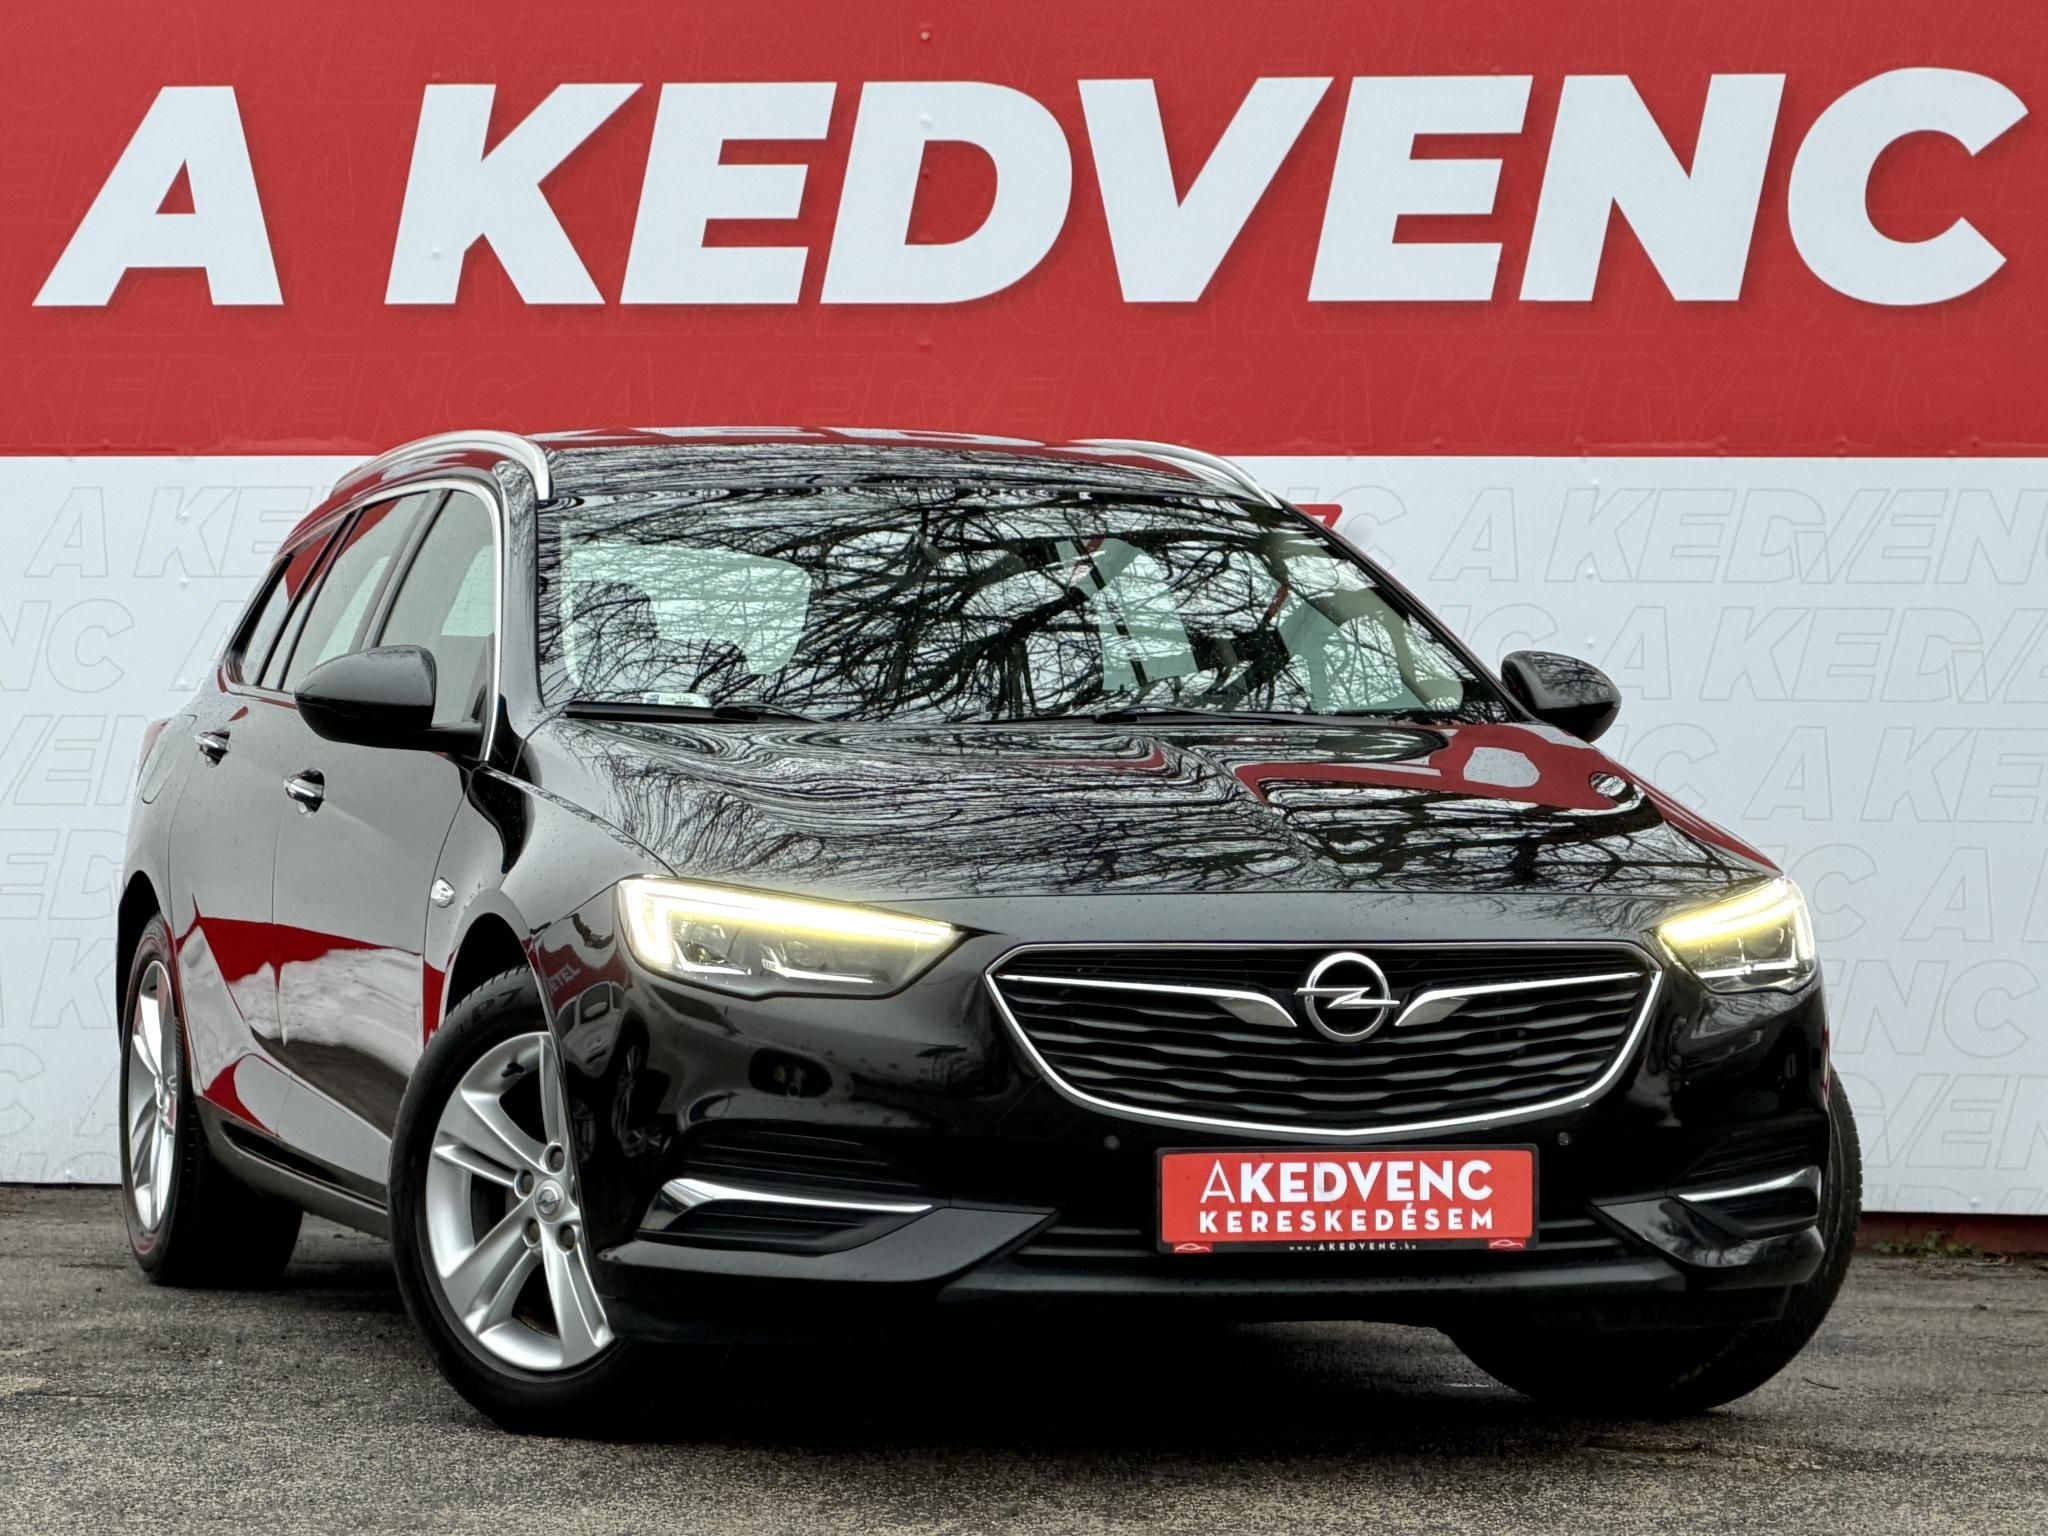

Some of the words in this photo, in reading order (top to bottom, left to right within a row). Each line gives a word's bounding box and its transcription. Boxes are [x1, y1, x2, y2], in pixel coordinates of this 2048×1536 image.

[32, 85, 284, 306] A
[383, 66, 2030, 307] KEDVENC
[1200, 1203, 1494, 1232] KERESKEDÉSEM
